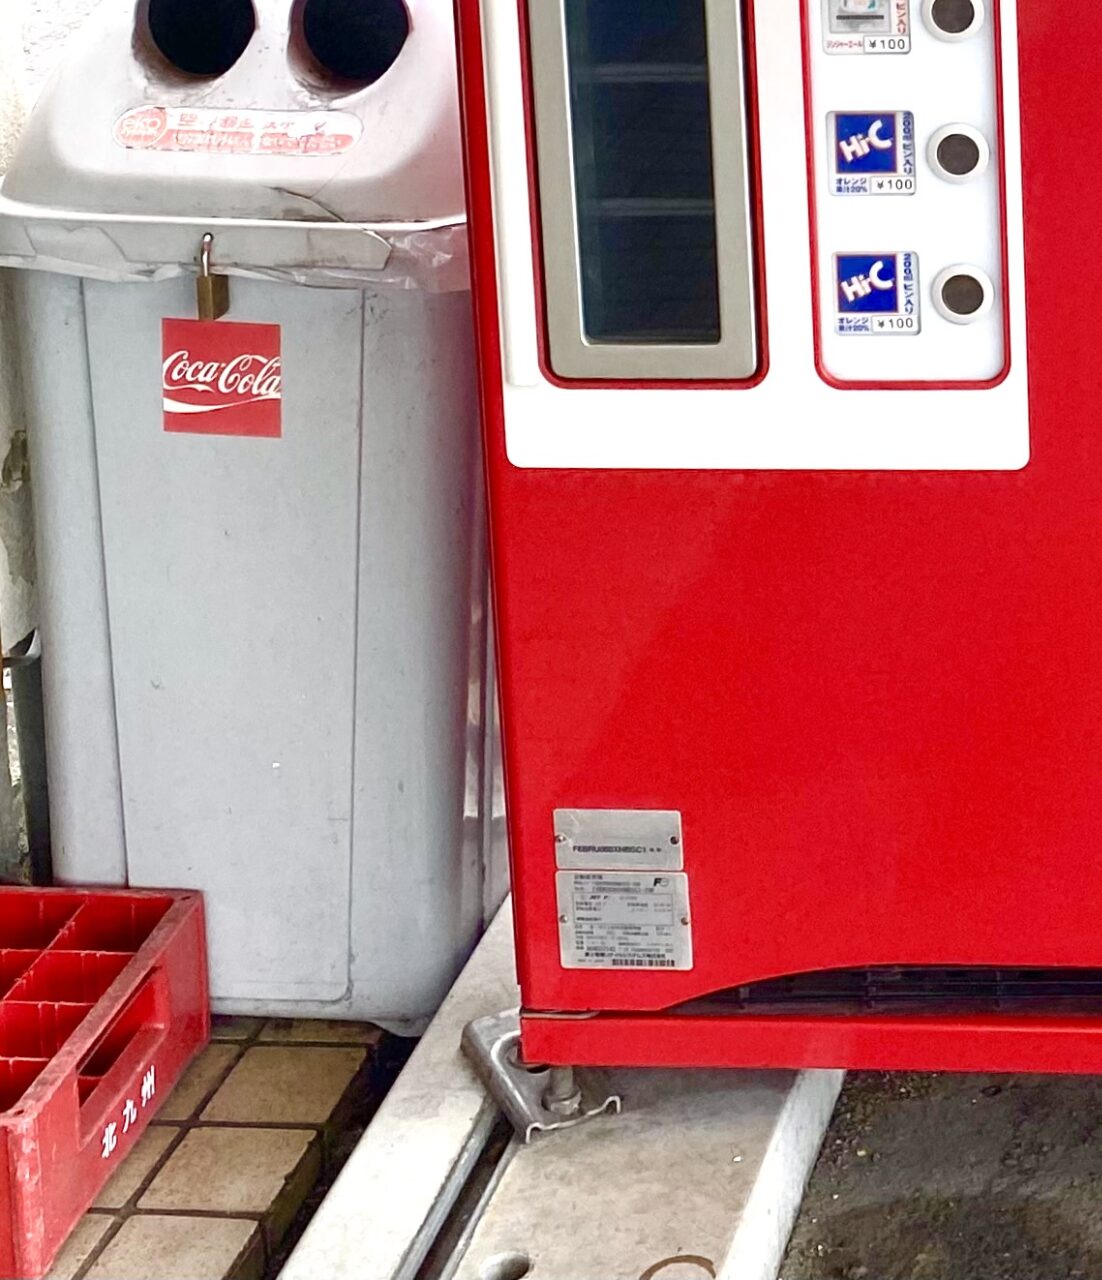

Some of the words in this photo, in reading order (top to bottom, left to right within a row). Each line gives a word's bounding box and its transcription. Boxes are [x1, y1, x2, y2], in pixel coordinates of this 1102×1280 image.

[869, 39, 906, 50] ¥100
[835, 176, 867, 185] オレンジ
[877, 179, 913, 190] ¥100
[838, 317, 869, 325] オレンジ
[878, 318, 914, 329] ¥100
[162, 349, 281, 398] Coca-Cola
[101, 1065, 156, 1159] 北九州
